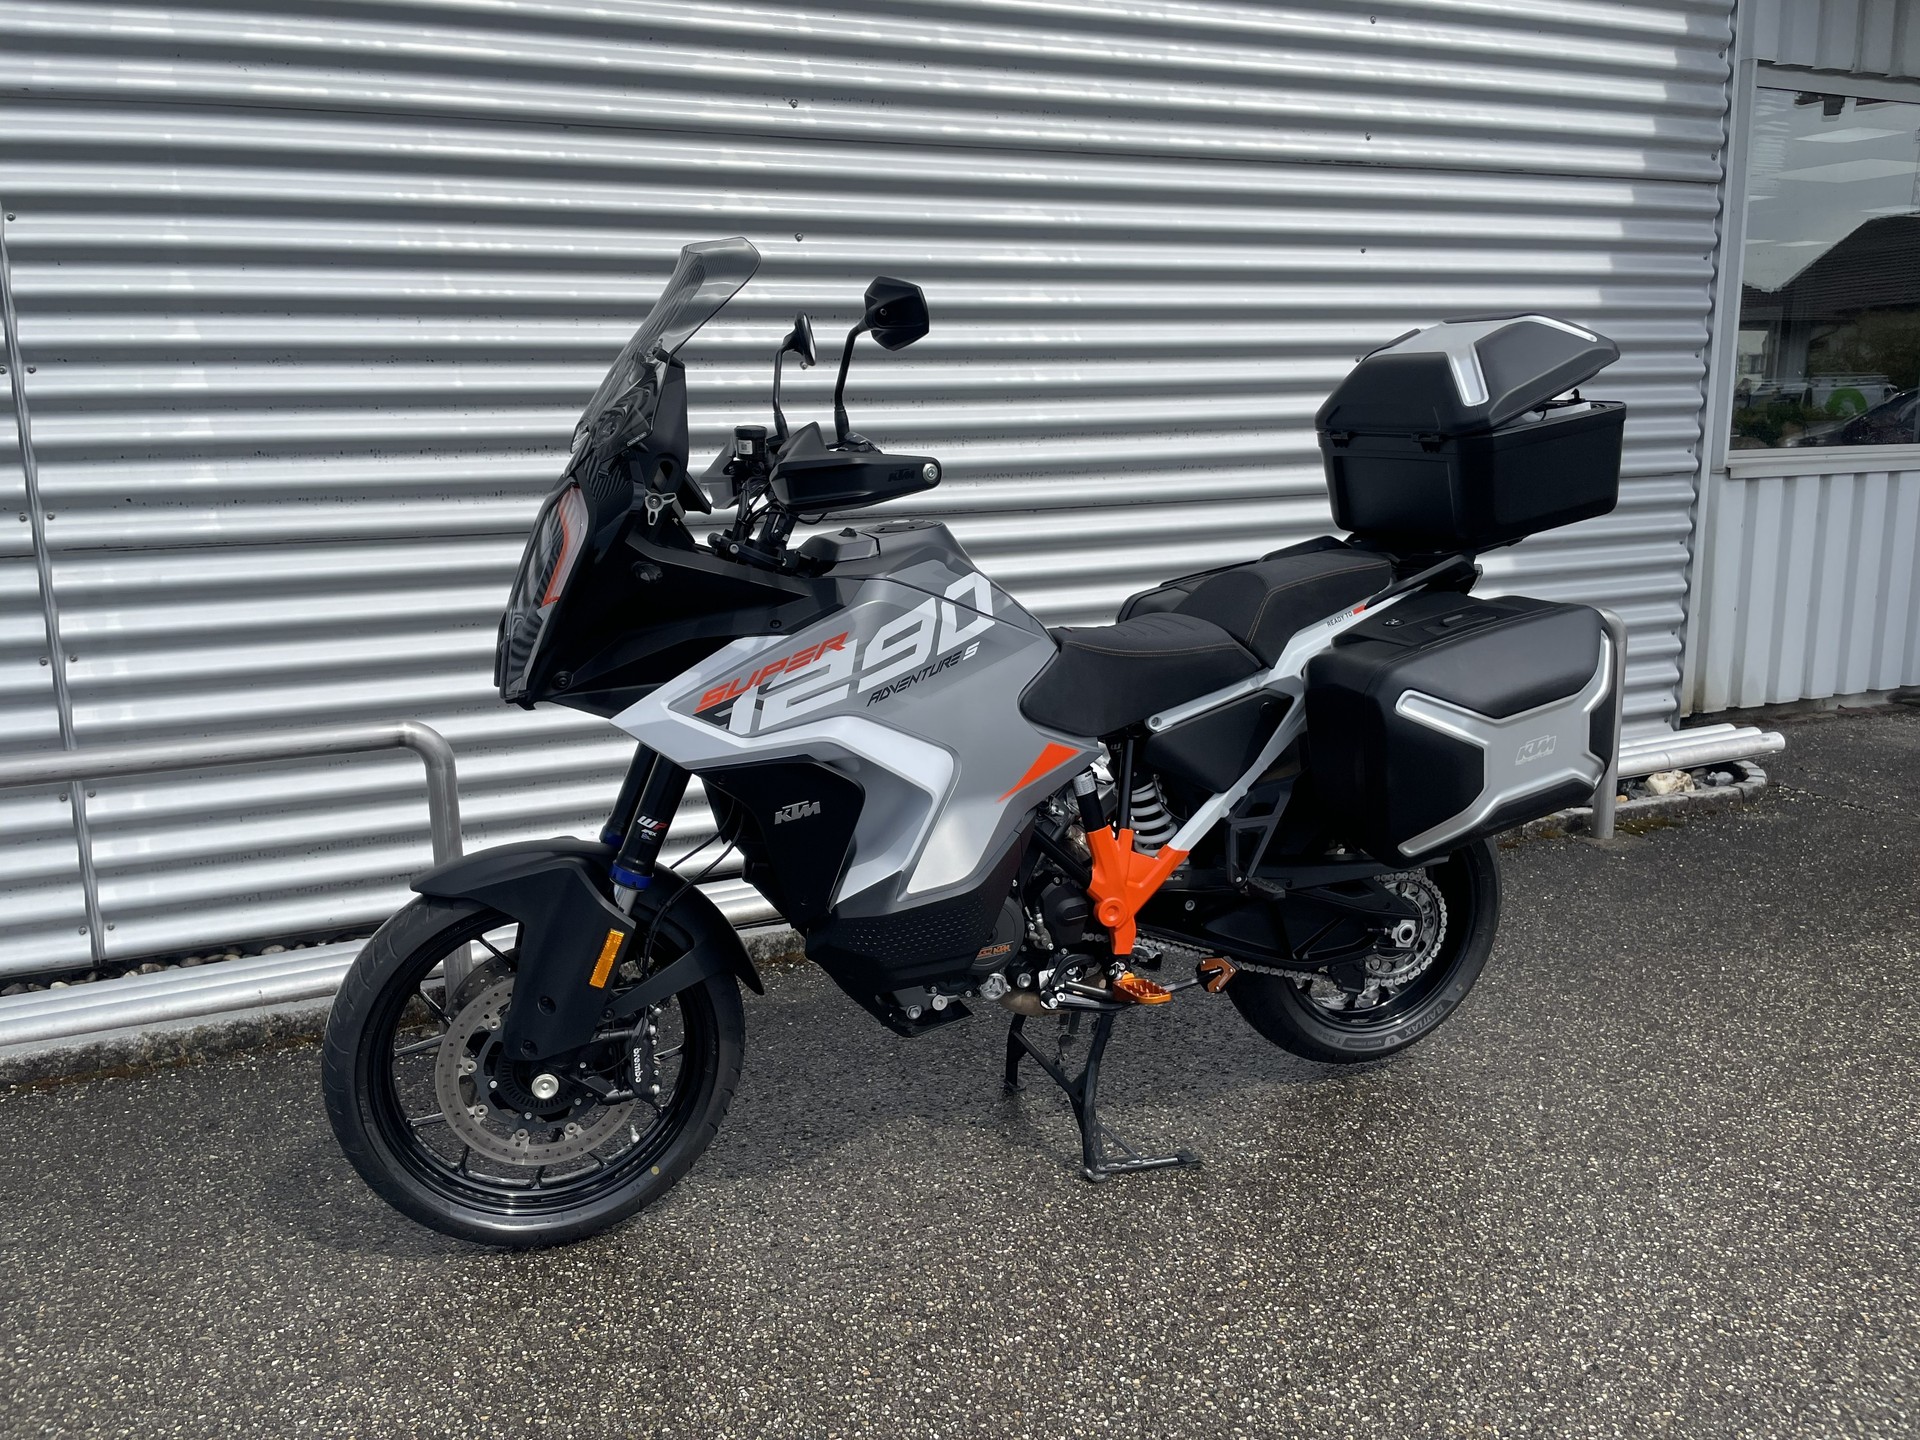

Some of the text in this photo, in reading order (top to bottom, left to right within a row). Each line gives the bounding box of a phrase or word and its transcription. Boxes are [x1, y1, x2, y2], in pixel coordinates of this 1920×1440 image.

[888, 468, 915, 482] KTM
[1326, 610, 1353, 627] READY TO
[728, 572, 995, 735] 1290
[694, 631, 849, 713] SUPER
[866, 641, 981, 707] ADVENTURE S
[1515, 735, 1557, 762] KTM
[636, 815, 668, 831] WP
[774, 800, 821, 825] KTM
[633, 1047, 643, 1083] brembo
